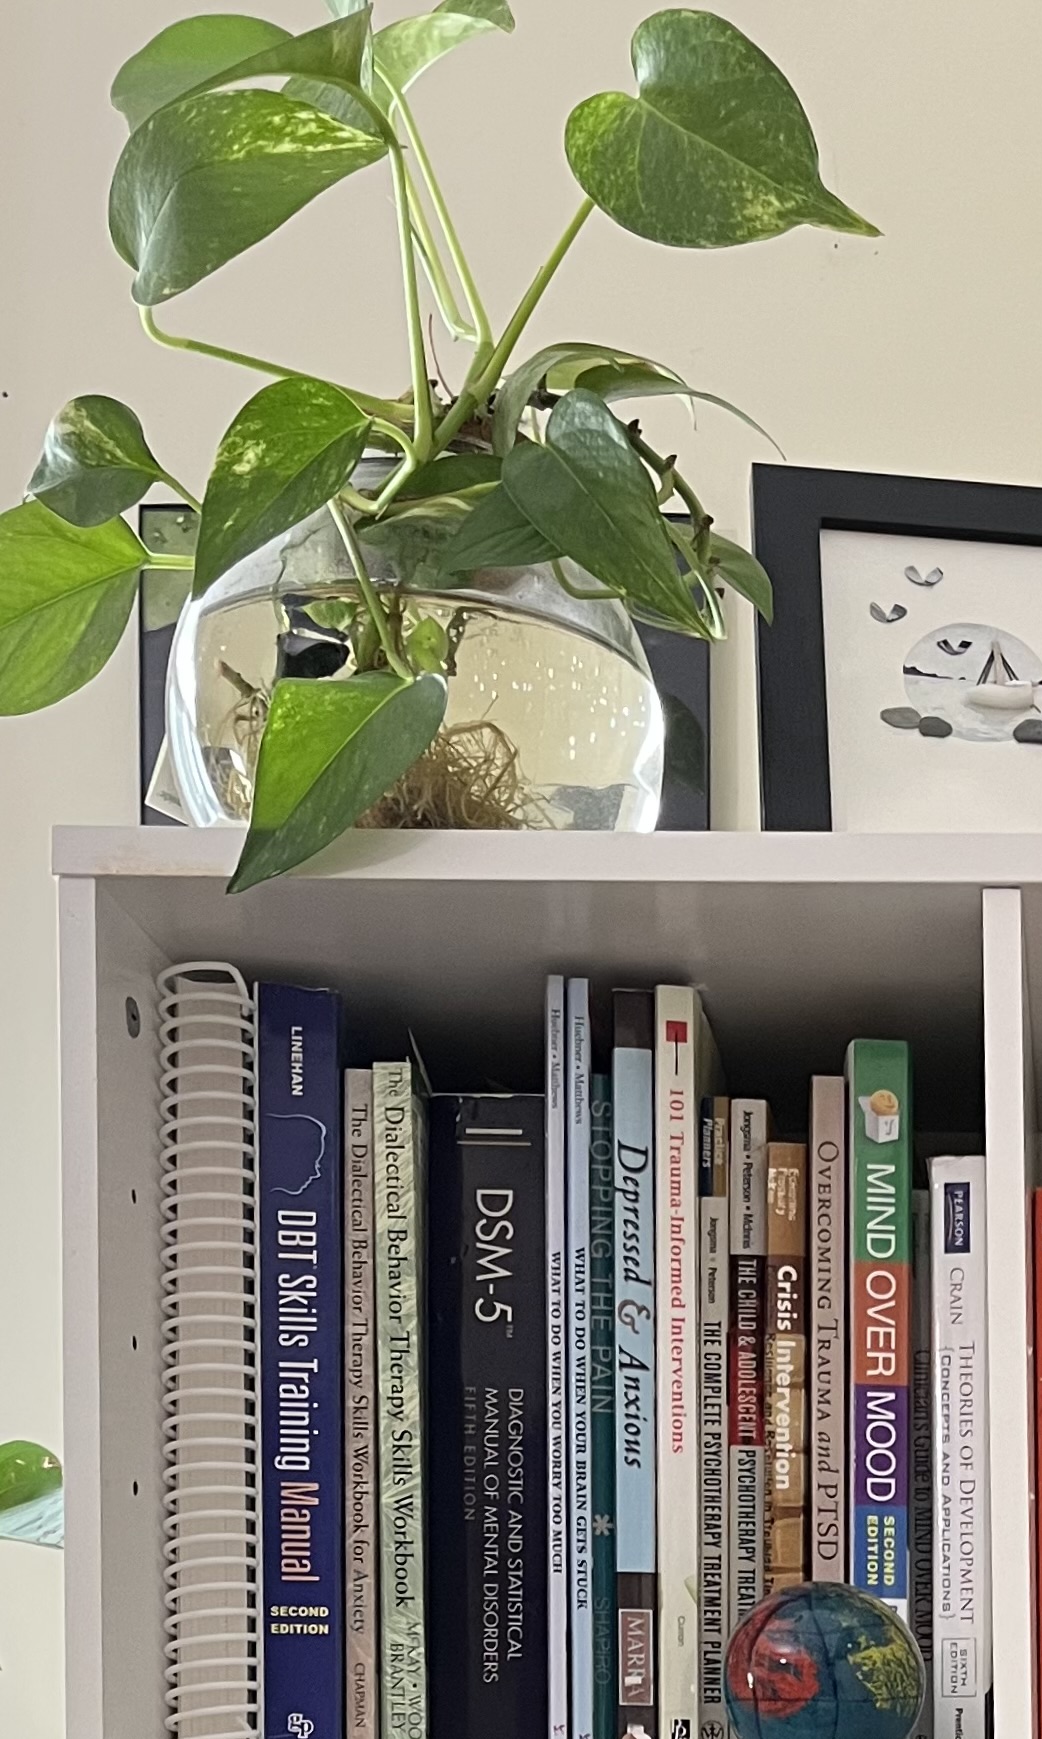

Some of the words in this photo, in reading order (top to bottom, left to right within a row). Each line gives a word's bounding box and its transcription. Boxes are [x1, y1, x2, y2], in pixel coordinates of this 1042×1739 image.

[291, 1026, 303, 1095] LINEHAN
[614, 1140, 651, 1287] Depressed
[866, 1164, 895, 1258] MIND
[575, 1248, 585, 1295] WHAT
[278, 1274, 318, 1346] Skills
[575, 1300, 585, 1321] TO
[575, 1327, 585, 1350] DO
[618, 1300, 651, 1334] &
[866, 1271, 896, 1376] OVER
[274, 1359, 319, 1470] Training
[575, 1356, 587, 1405] WHEN
[618, 1345, 651, 1469] Anxious
[483, 1388, 499, 1468] MANUAL
[508, 1388, 524, 1504] DIAGNOSTIC
[575, 1411, 587, 1453] YOUR
[866, 1391, 896, 1500] MOOD
[483, 1474, 499, 1498] OF
[576, 1461, 587, 1510] BRAIN
[280, 1482, 319, 1582] Manual
[483, 1506, 498, 1576] MENTAL
[508, 1510, 523, 1552] AND
[576, 1516, 588, 1554] GETS
[867, 1515, 878, 1585] EDITION
[884, 1516, 895, 1585] SECOND
[270, 1606, 329, 1617] SECOND
[507, 1558, 523, 1660] STATISTICAL
[577, 1559, 588, 1610] STUCK
[270, 1623, 329, 1634] EDITION
[483, 1583, 498, 1683] DISORDERS
[354, 1662, 366, 1728] CHAPMAN
